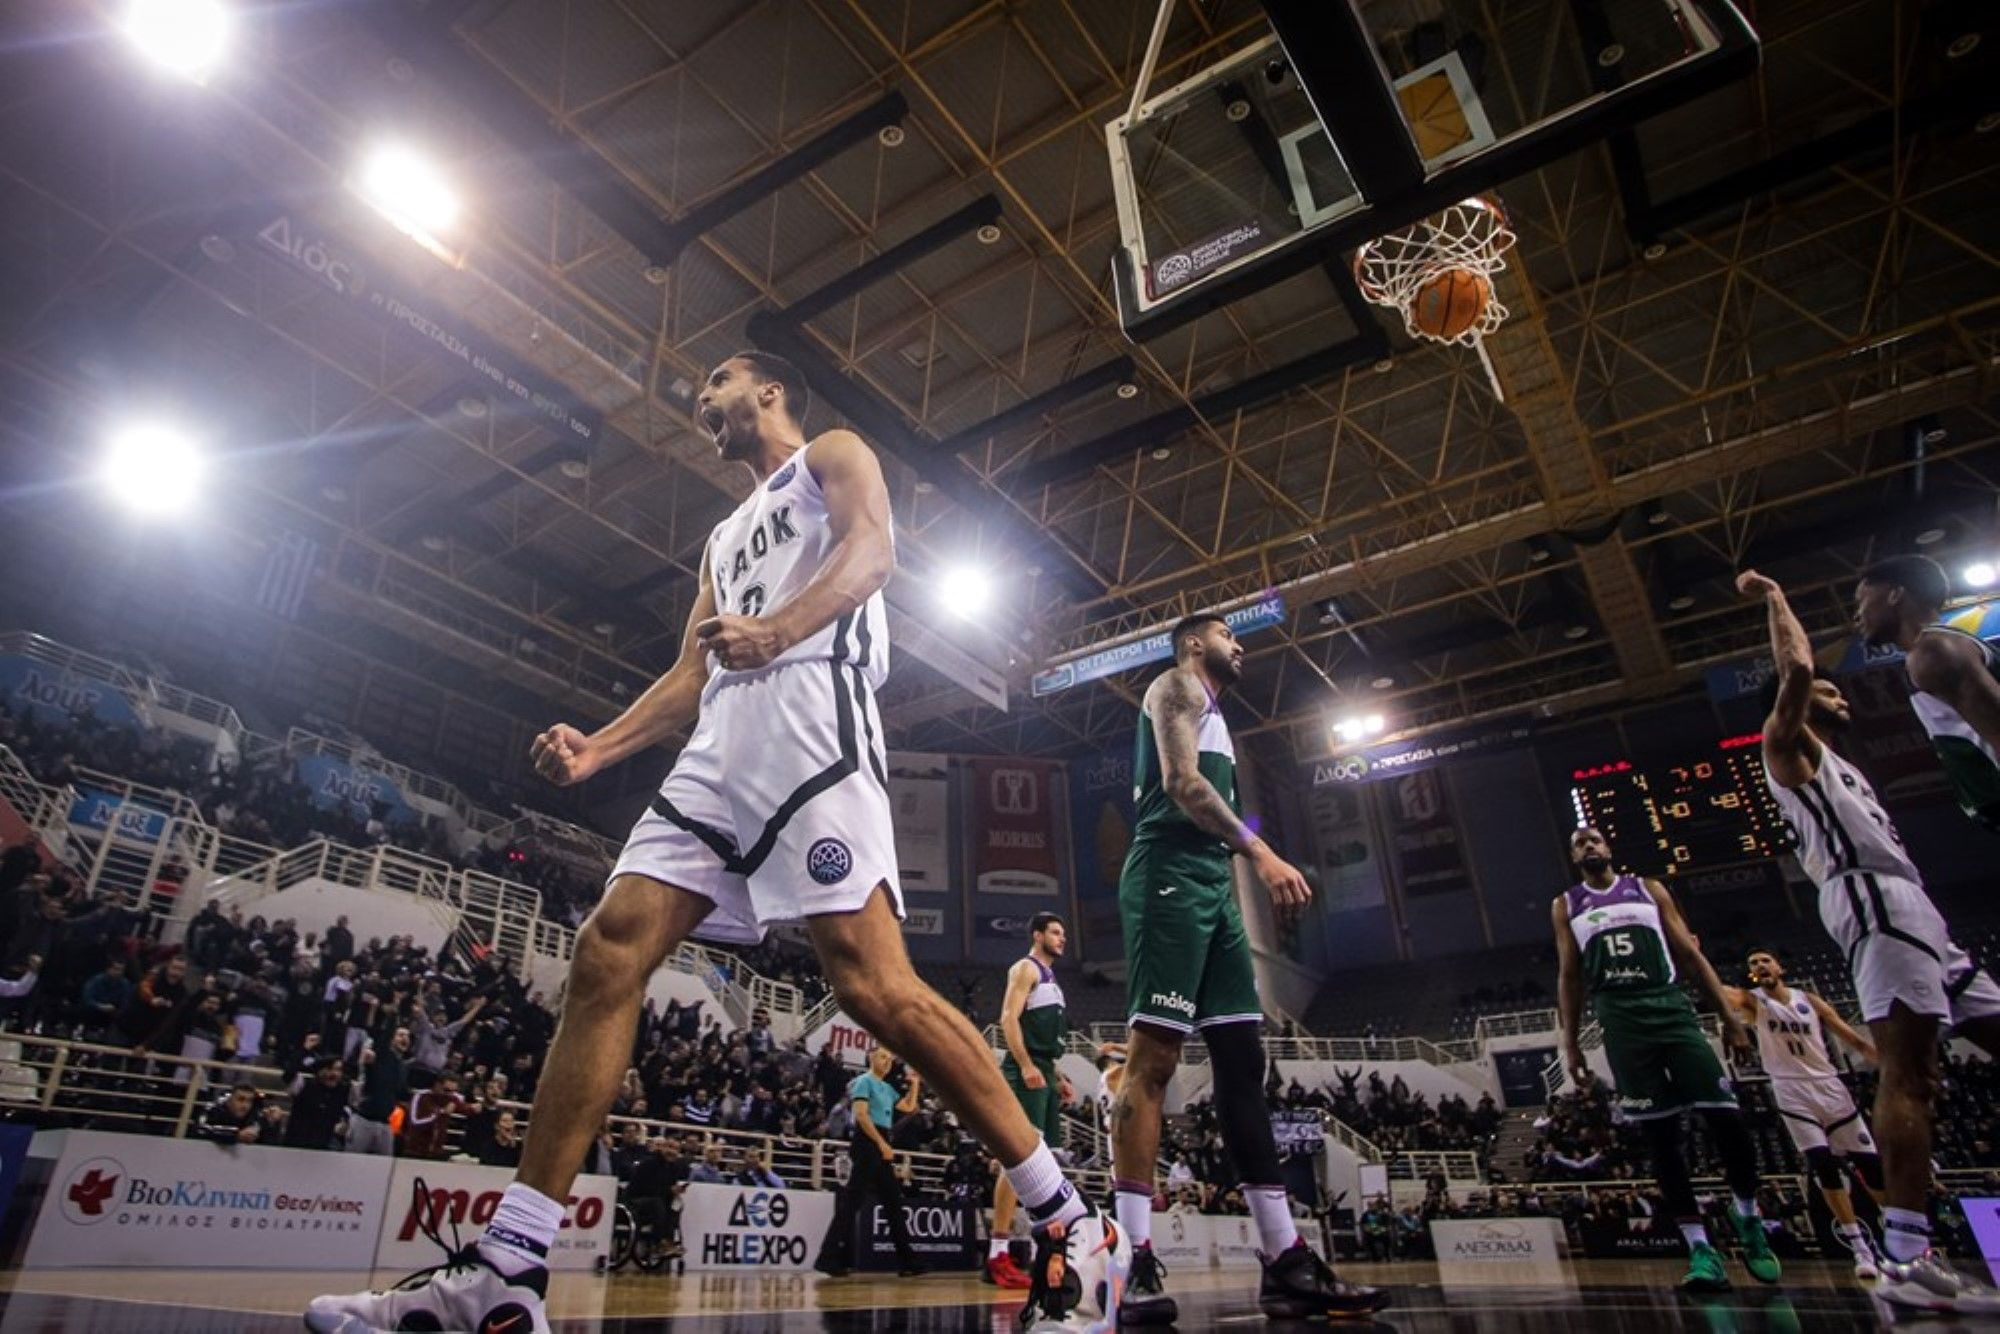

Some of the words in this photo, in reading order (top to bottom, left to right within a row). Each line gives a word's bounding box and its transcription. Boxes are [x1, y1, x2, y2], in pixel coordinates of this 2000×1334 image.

[258, 216, 350, 293] Διός
[1226, 601, 1281, 627] ΟΤΗΤΑΣ
[1314, 761, 1360, 785] Διός
[91, 800, 148, 837] λυξ
[1603, 932, 1635, 957] 15
[1151, 990, 1197, 1019] málag
[1767, 1020, 1812, 1035] PAOK
[1787, 1039, 1805, 1056] 11
[118, 1212, 215, 1229] ΟΜΙΛΟΣ
[229, 1217, 361, 1232] ΒΙΟΙΑΤΡΙΚΗ
[873, 1204, 963, 1238] FRCOM
[702, 1232, 807, 1265] HELEXPO
